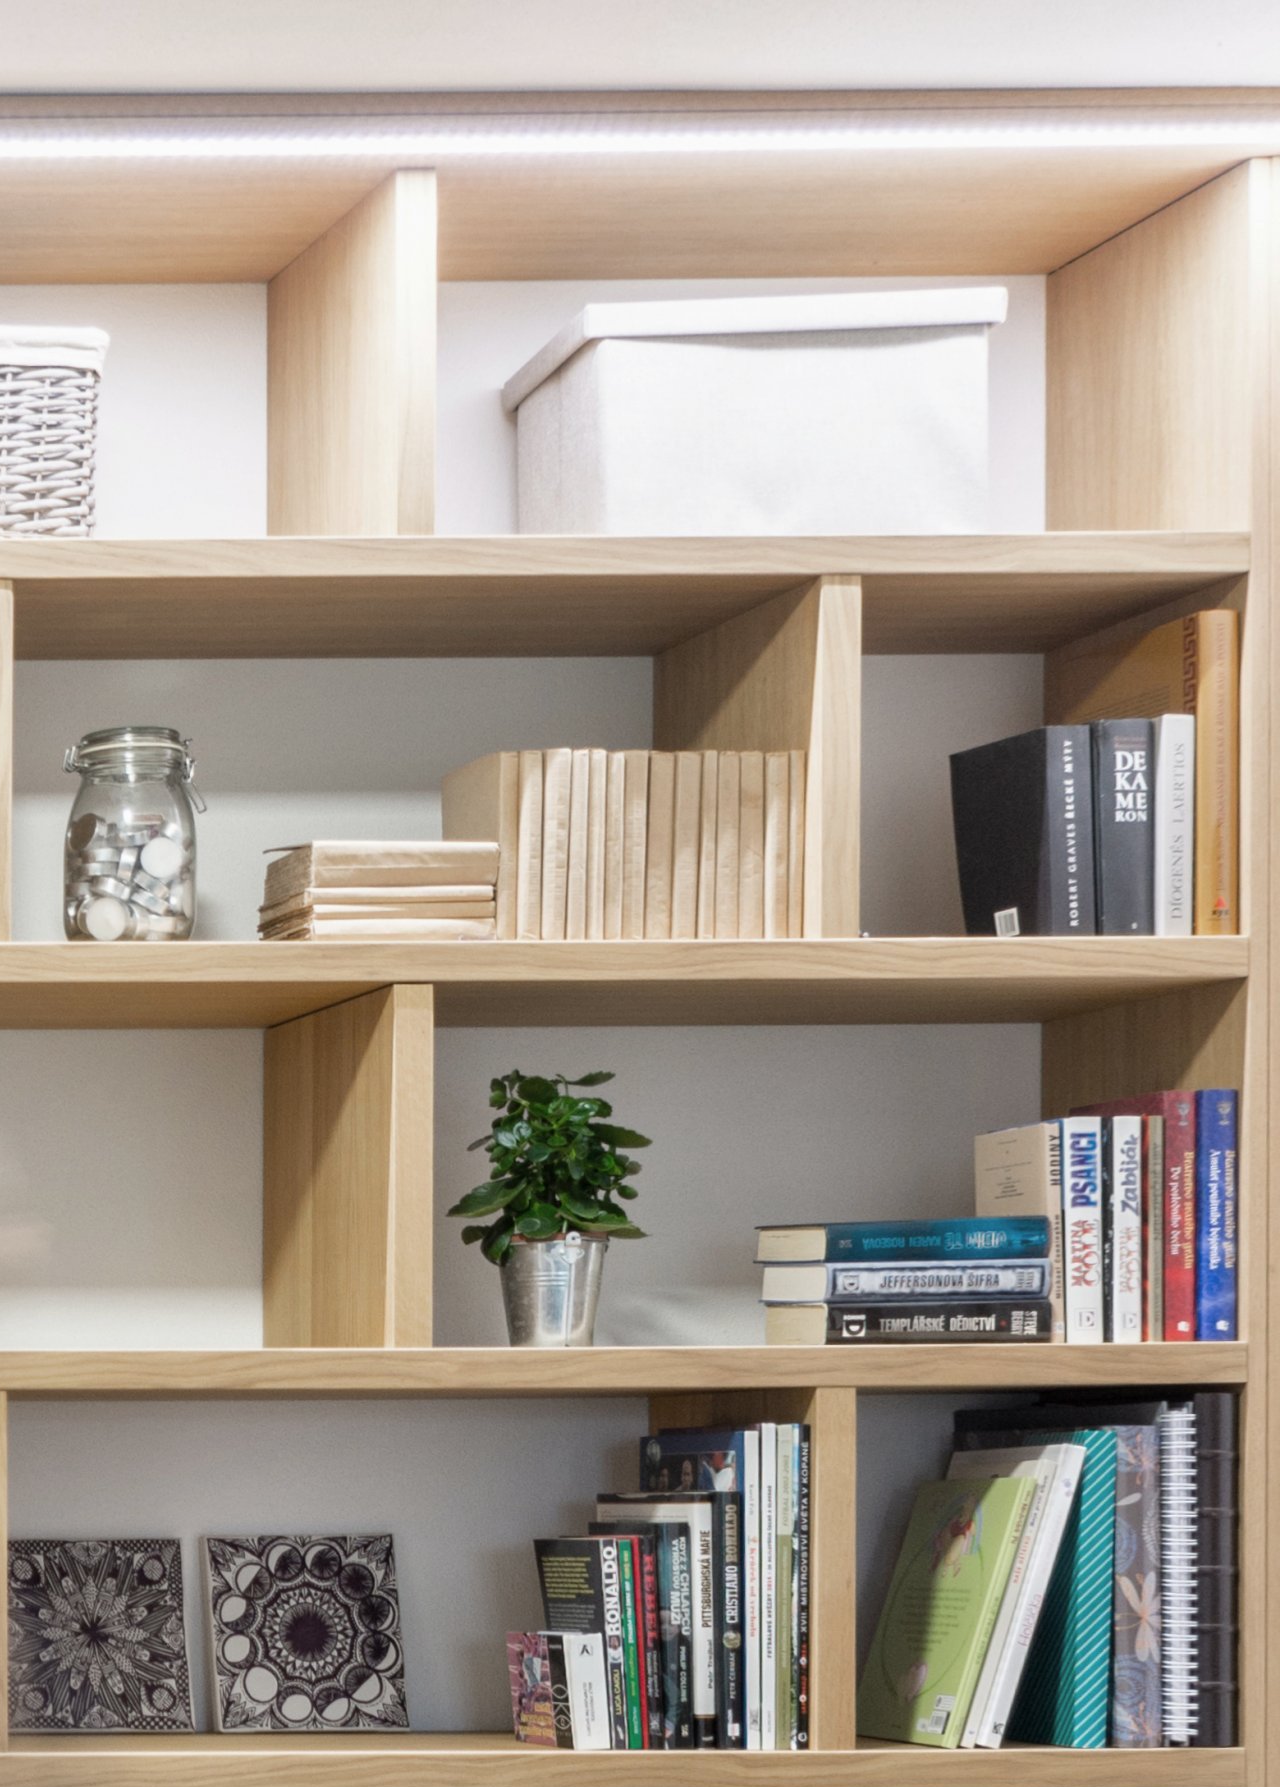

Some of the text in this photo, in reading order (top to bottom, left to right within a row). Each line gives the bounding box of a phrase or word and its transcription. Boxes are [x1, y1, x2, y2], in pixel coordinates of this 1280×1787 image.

[1114, 751, 1146, 771] DE
[1114, 772, 1148, 791] KA
[1115, 793, 1147, 809] ME
[1115, 811, 1147, 822] RON
[1049, 1134, 1060, 1186] HODINY
[1070, 1131, 1097, 1209] PSANCI
[1071, 1219, 1085, 1287] MARTINA
[880, 1272, 999, 1288] JEFFERSONOVA ŠIFRA
[880, 1315, 946, 1332] TEMPLÁŘSKÉ
[950, 1313, 996, 1331] DĚDICTVÍ
[1024, 1310, 1037, 1335] STEVE
[697, 1529, 711, 1628] PITTSBURGHSKÁ MAFIE
[725, 1504, 738, 1623] CRISTIANO RONALDO
[604, 1546, 621, 1635] RONALDO
